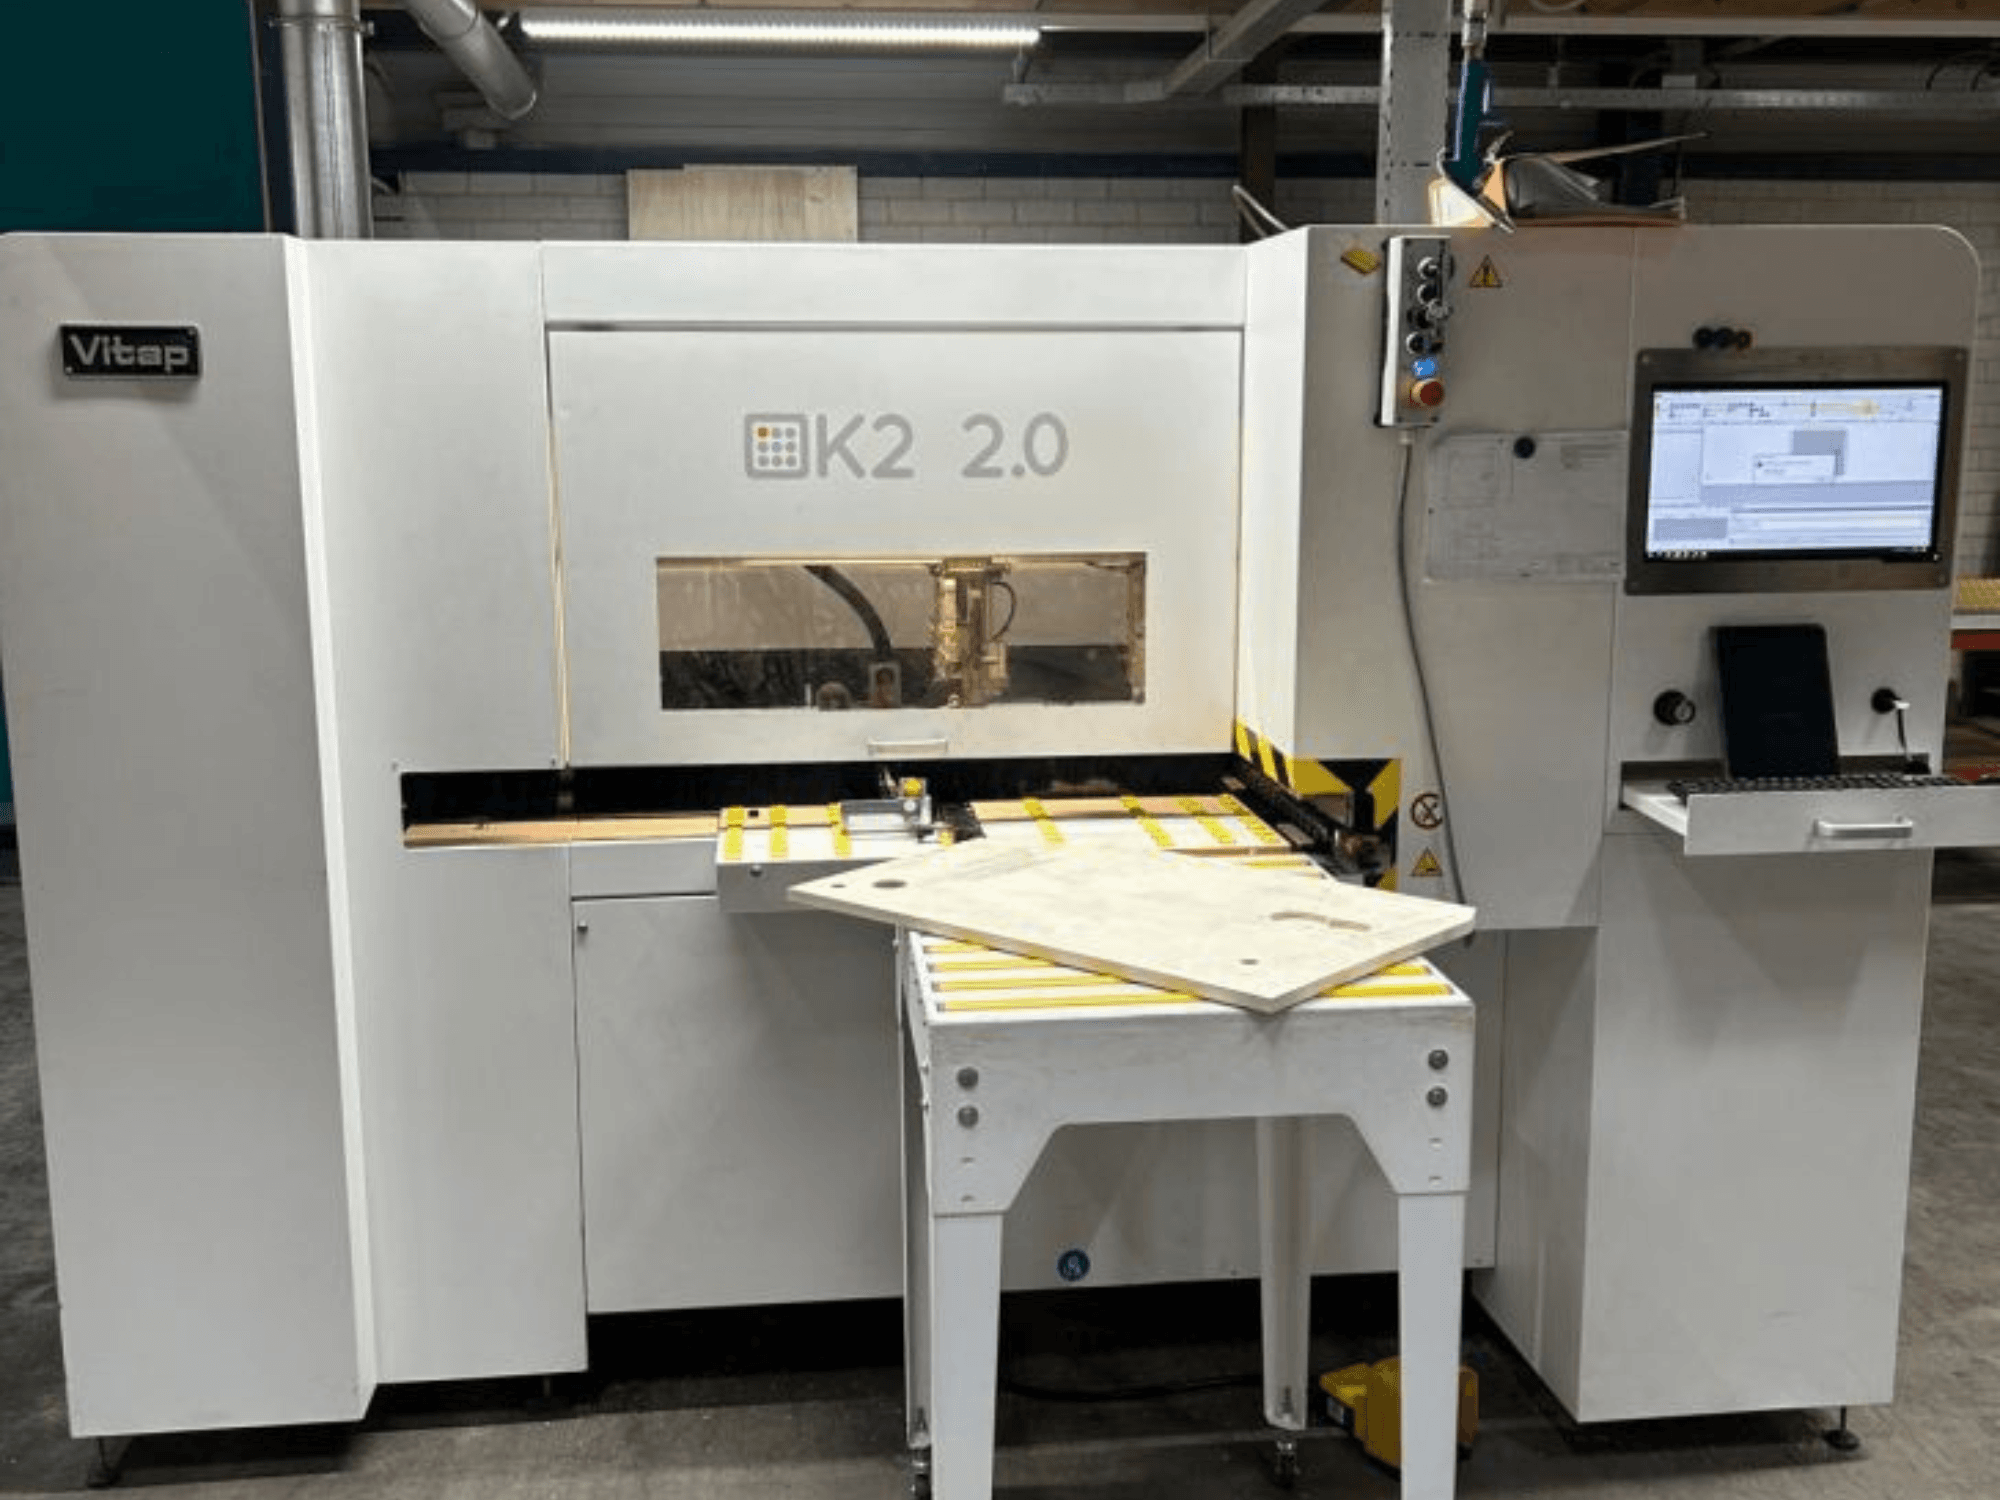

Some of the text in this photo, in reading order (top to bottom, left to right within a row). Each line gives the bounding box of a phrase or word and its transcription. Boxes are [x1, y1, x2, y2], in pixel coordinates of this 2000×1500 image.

[68, 335, 190, 374] Vitap
[815, 411, 1069, 479] K2 2.0
